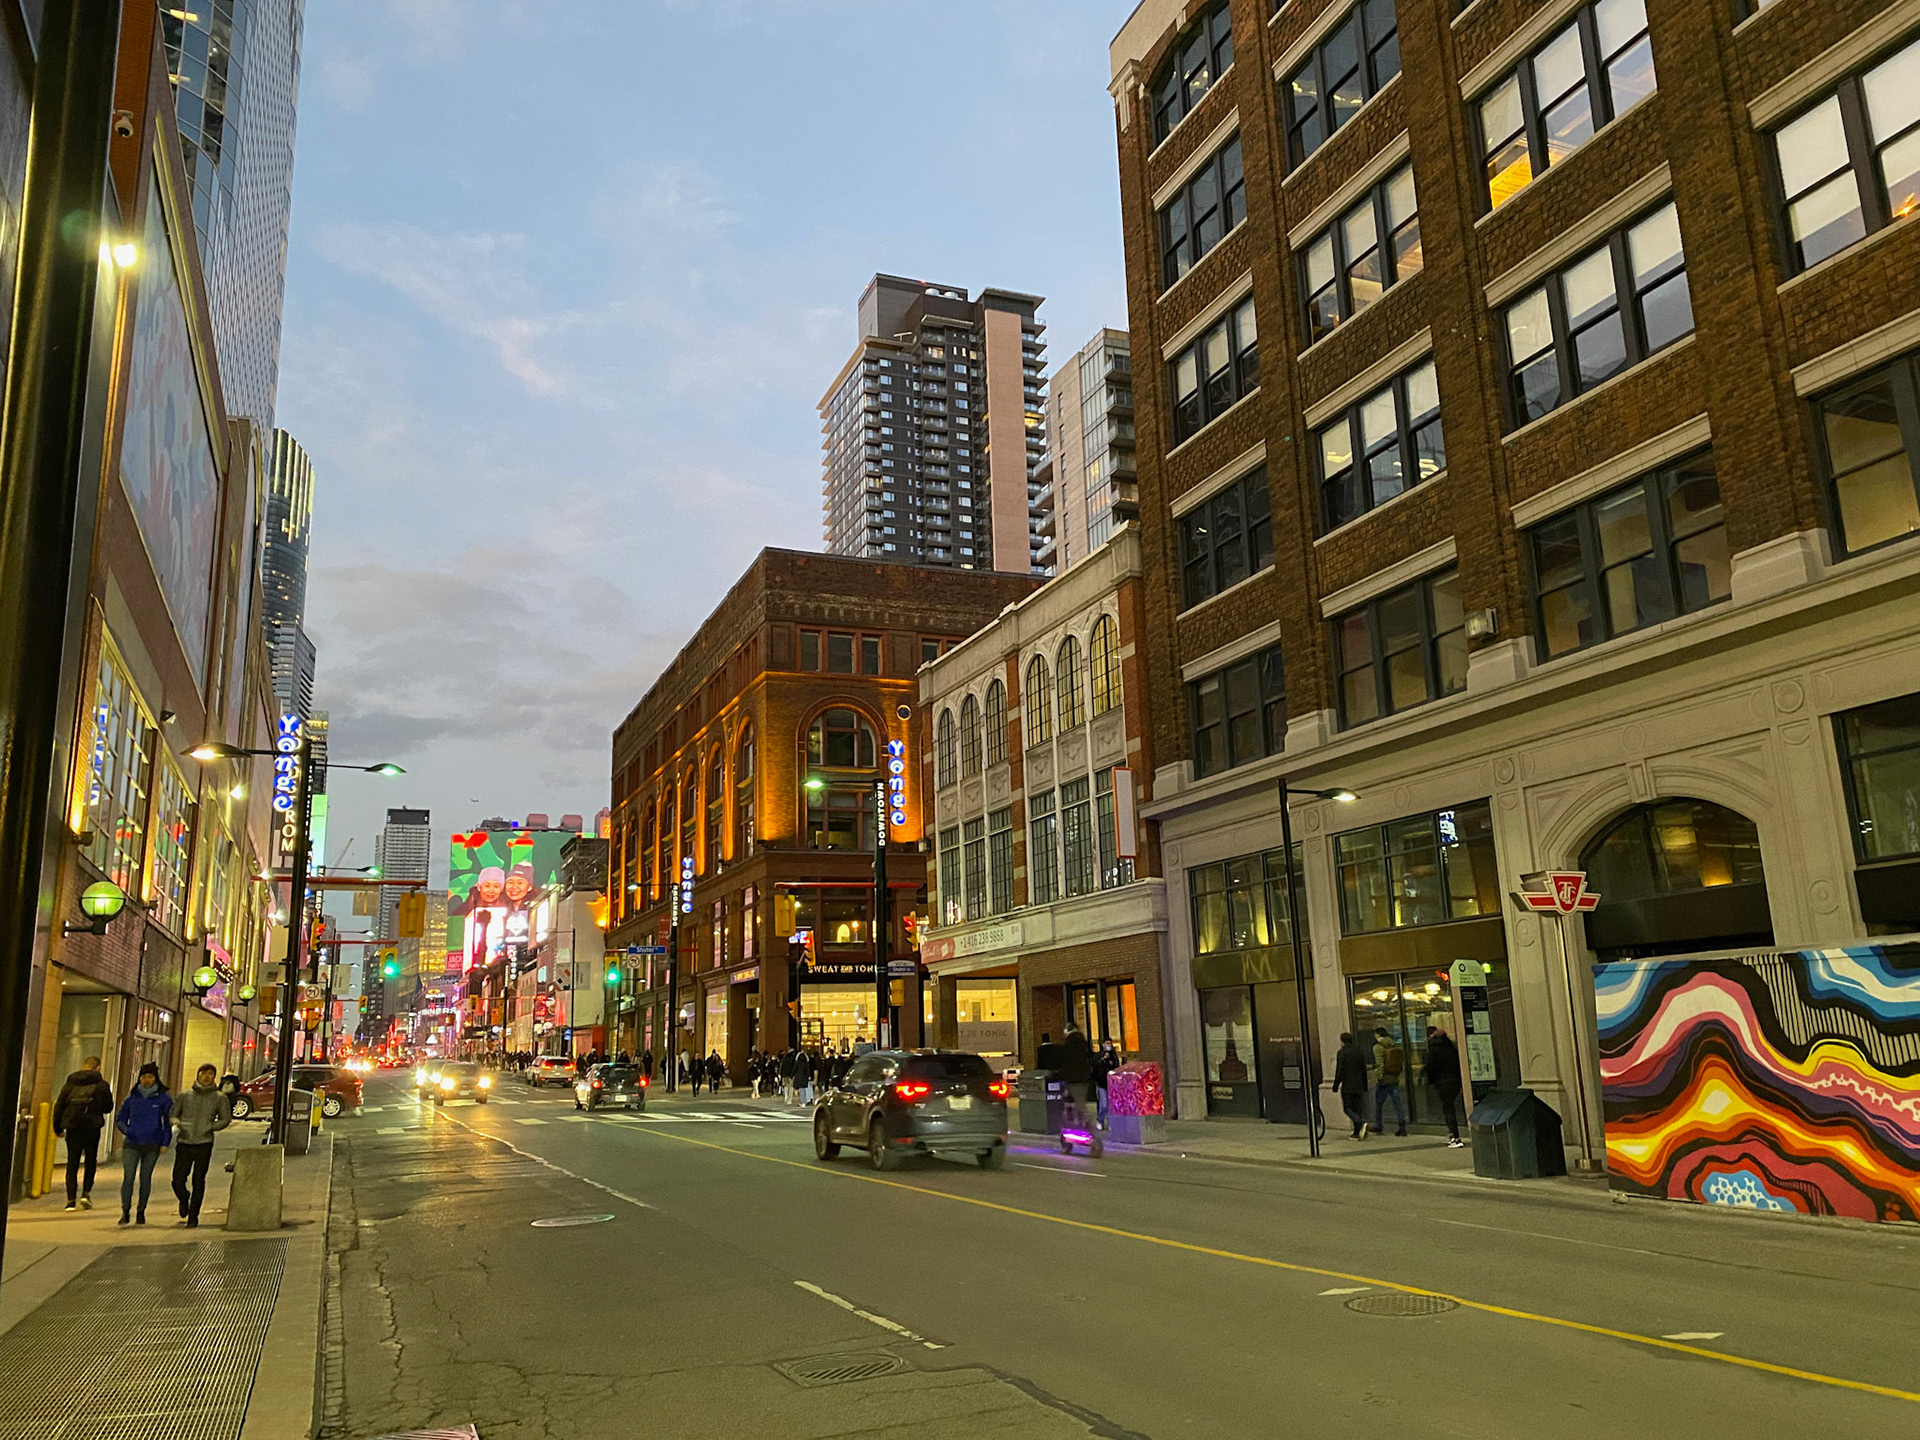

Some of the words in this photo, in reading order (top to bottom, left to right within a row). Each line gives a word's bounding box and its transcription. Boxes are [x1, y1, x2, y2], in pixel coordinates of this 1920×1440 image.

[273, 714, 299, 812] Yonge
[889, 739, 906, 827] Yonge
[876, 782, 886, 847] DOWNTOWN
[681, 857, 693, 914] Yonge
[808, 965, 838, 974] SWEAT
[967, 934, 978, 946] 416
